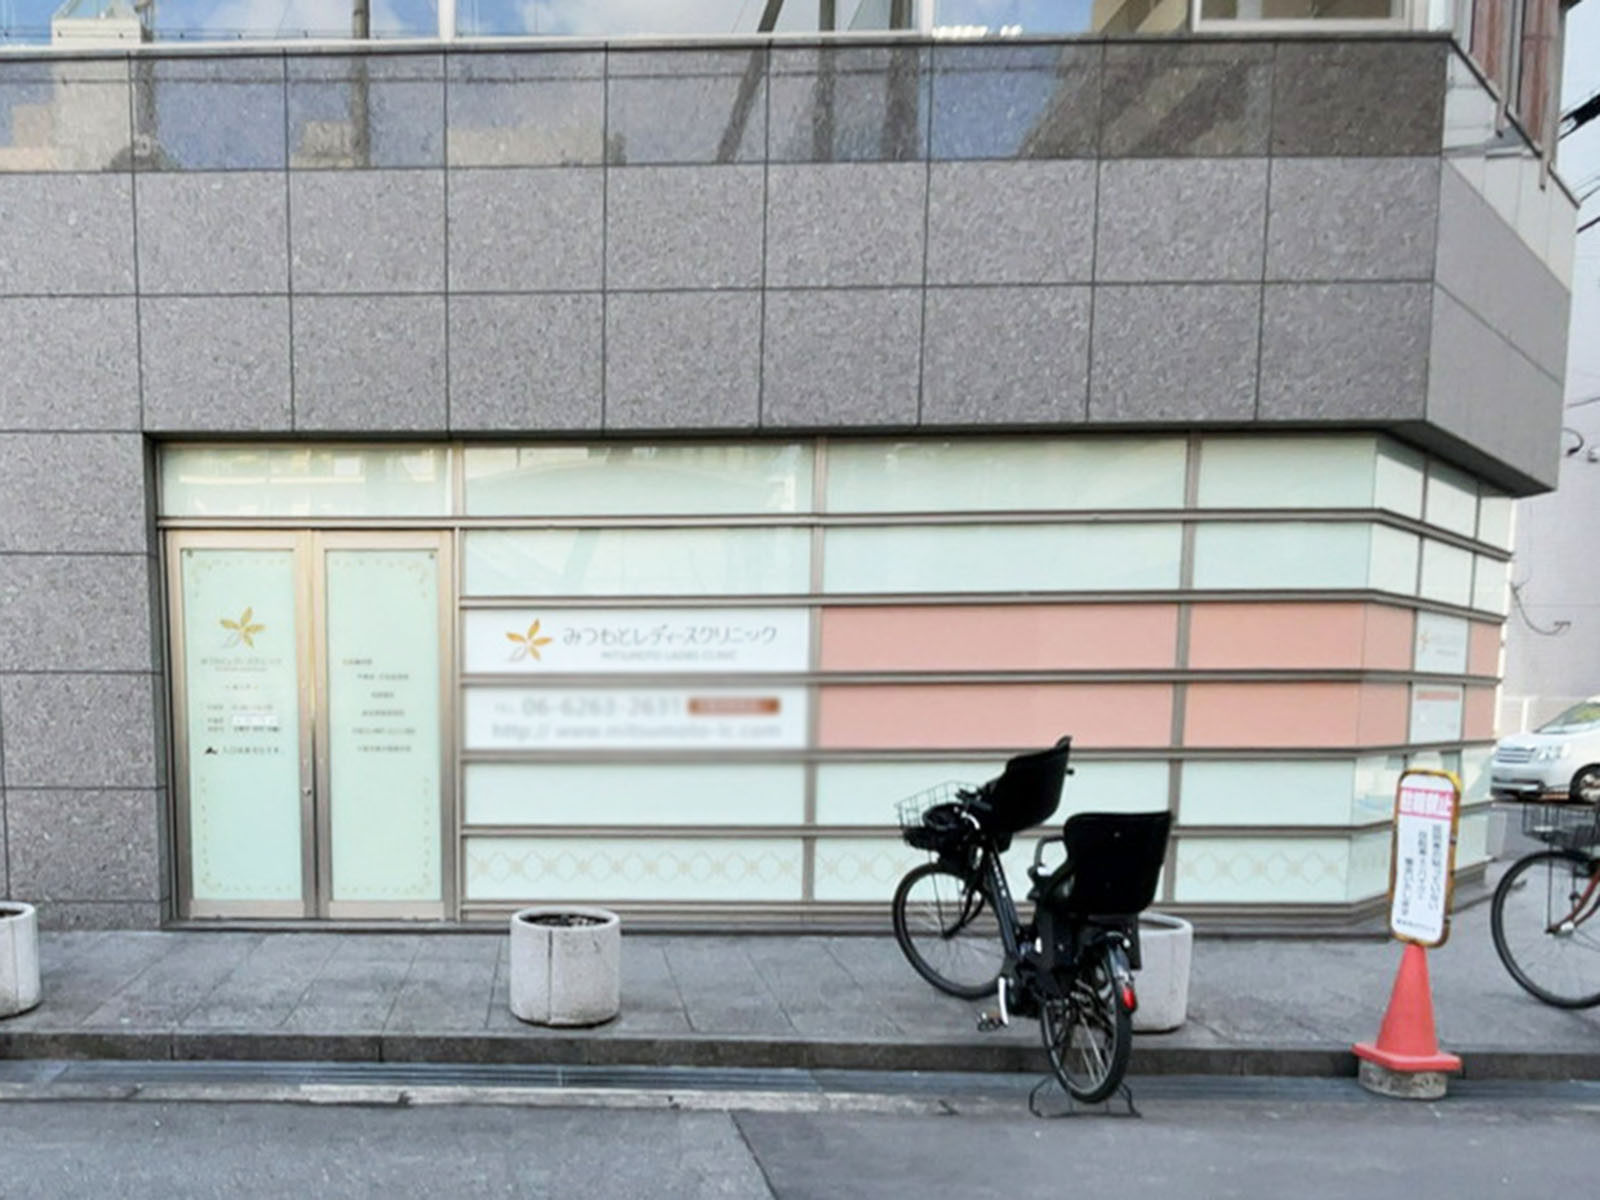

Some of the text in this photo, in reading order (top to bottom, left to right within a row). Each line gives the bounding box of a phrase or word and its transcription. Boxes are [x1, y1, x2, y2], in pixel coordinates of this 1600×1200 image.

[563, 624, 777, 645] みつもとレディースクリニック
